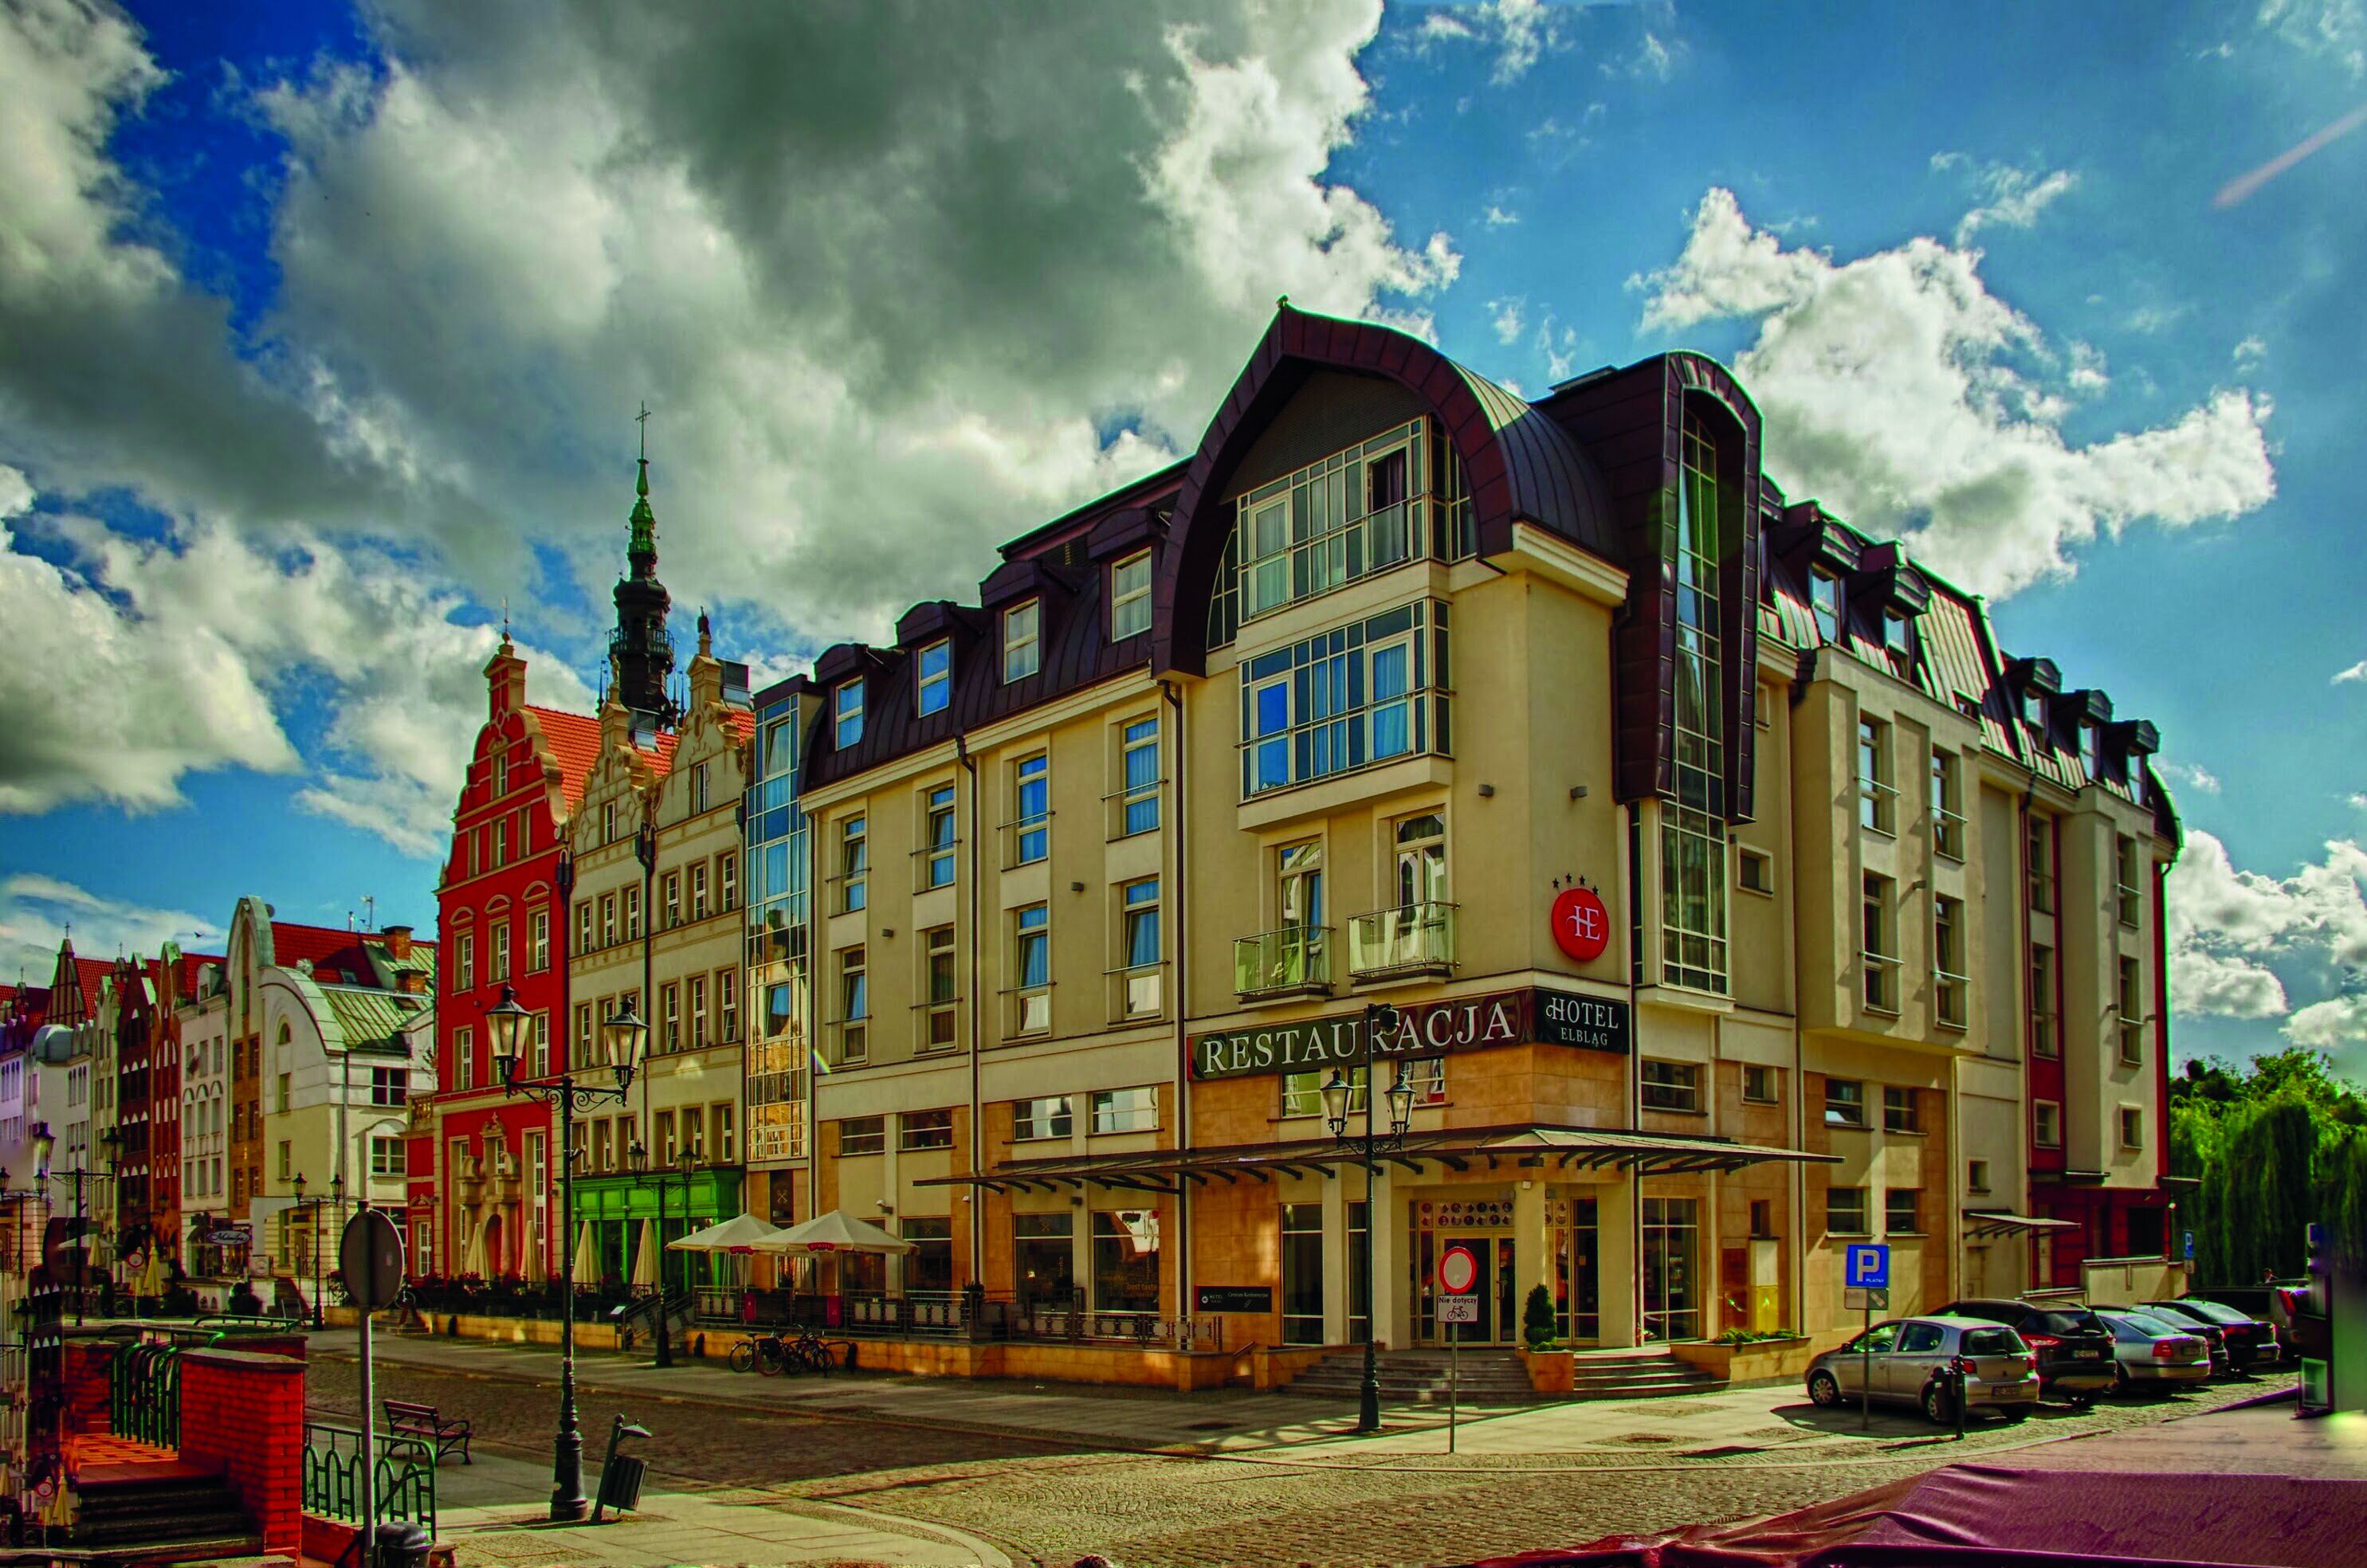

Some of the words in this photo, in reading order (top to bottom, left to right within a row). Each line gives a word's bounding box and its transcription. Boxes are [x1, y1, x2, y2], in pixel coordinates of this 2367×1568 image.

[1545, 997, 1619, 1029] HOTEL
[1203, 1002, 1515, 1073] RESTAURACJA
[1560, 1027, 1608, 1048] ELBLĄG
[1857, 1249, 1880, 1282] P
[1452, 1296, 1477, 1305] dotyczy
